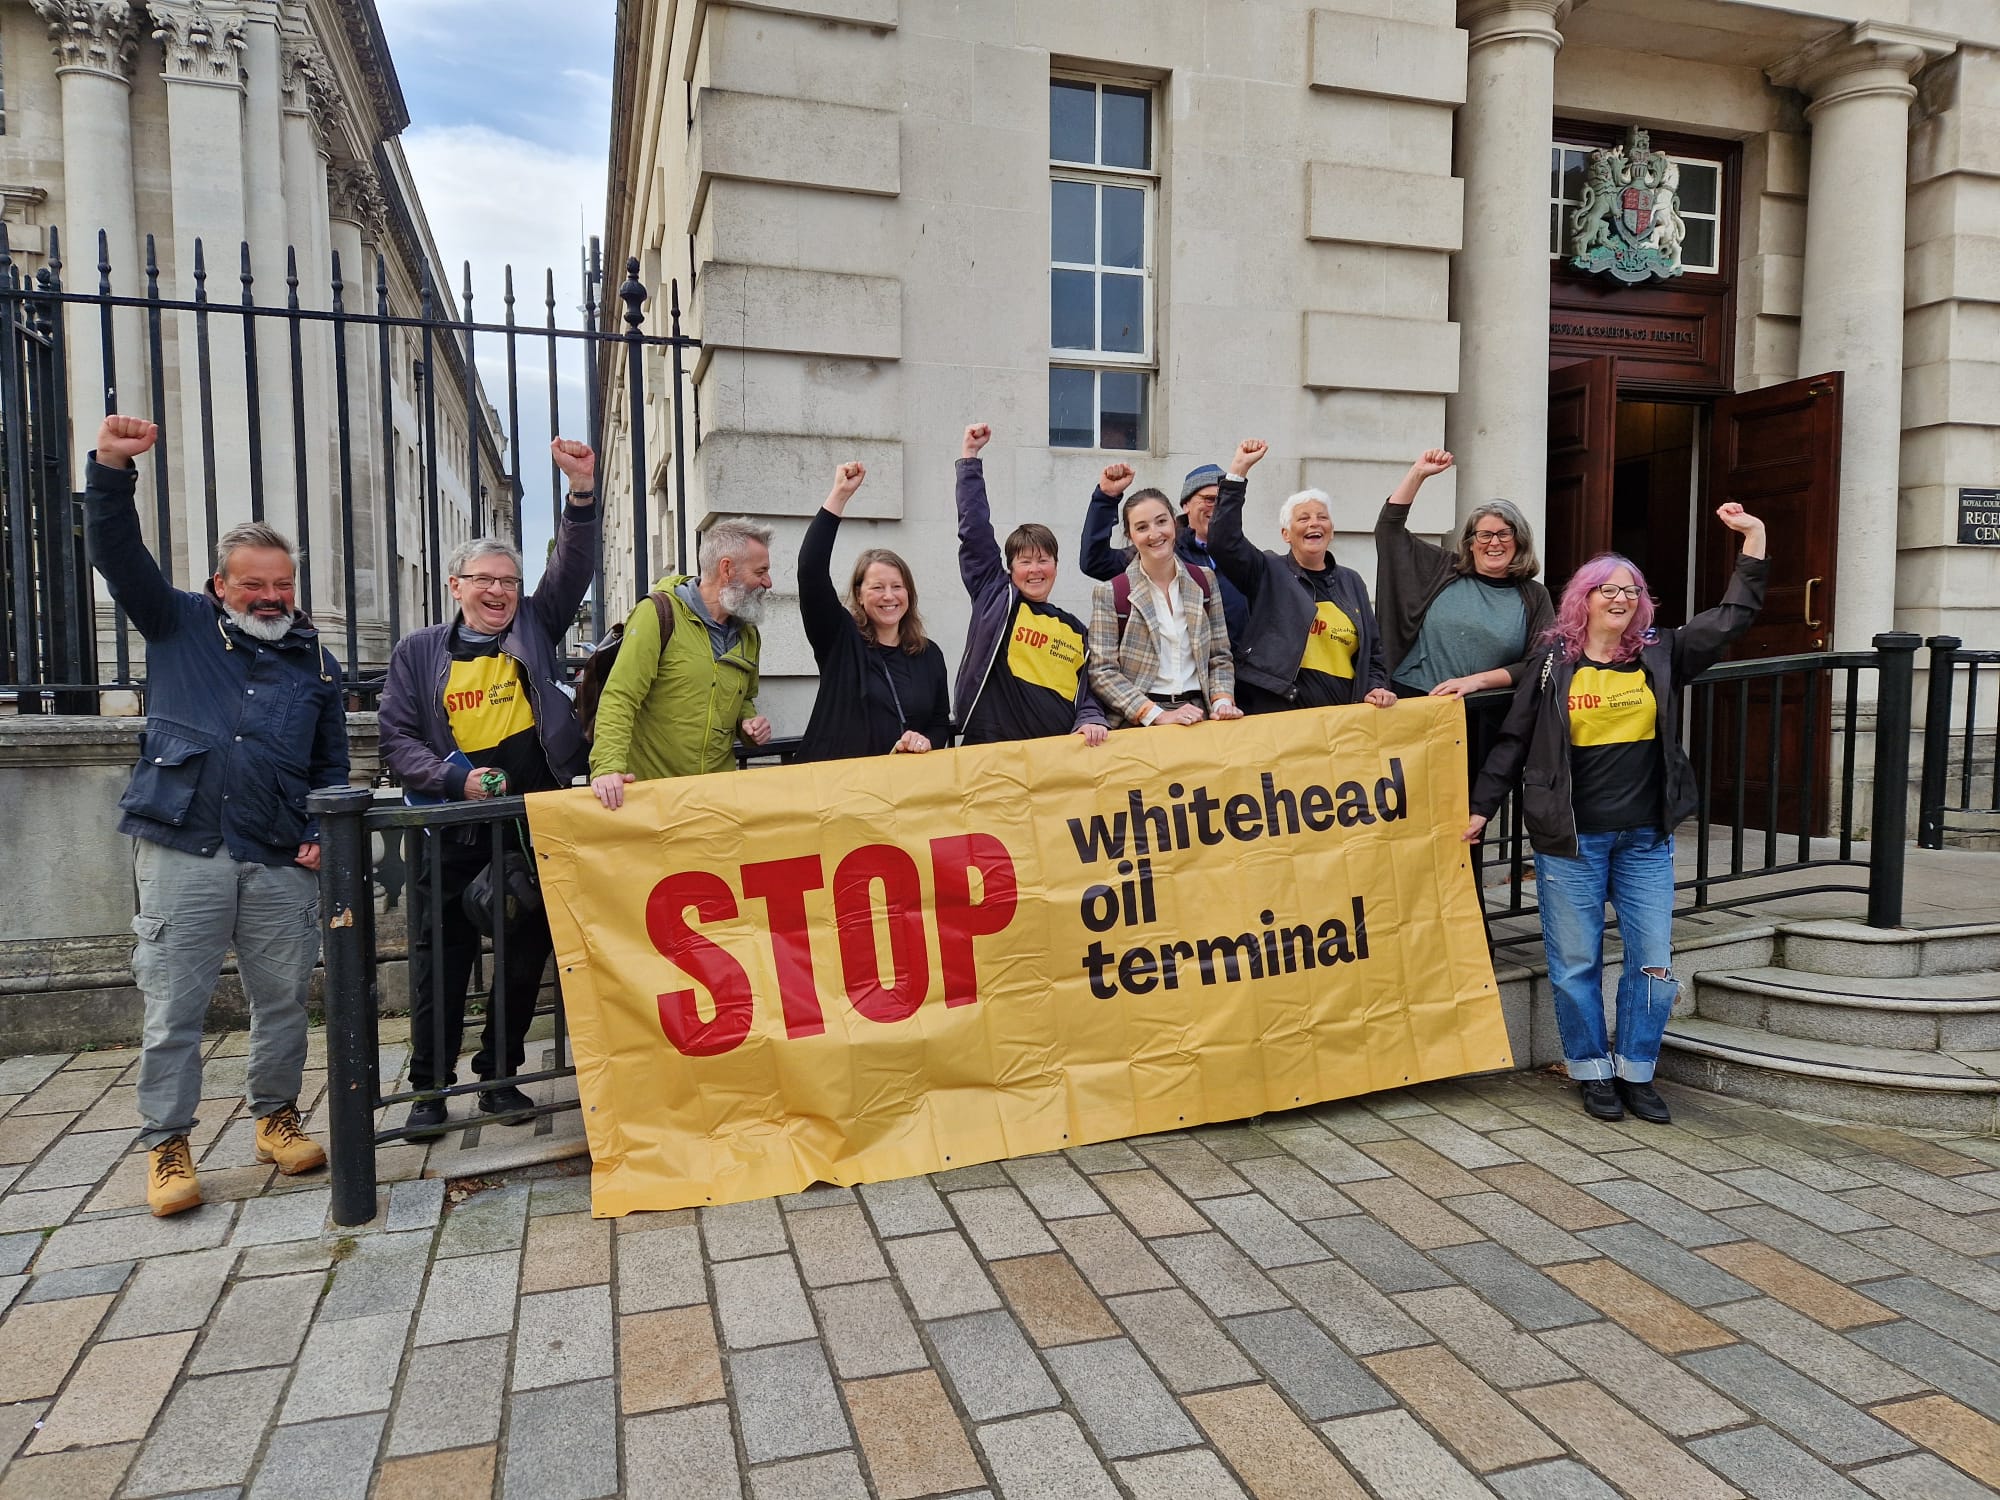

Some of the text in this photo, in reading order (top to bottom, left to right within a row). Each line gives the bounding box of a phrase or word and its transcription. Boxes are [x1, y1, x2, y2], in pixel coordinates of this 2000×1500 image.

[1652, 329, 1696, 343] JUSTICE
[1965, 511, 2000, 525] RECE
[1015, 626, 1048, 649] STOP
[446, 689, 484, 713] STOP
[1567, 693, 1602, 711] STOP
[1609, 698, 1643, 708] terminal
[1066, 757, 1407, 864] whitehead
[1080, 857, 1157, 933] oil
[645, 832, 1018, 1057] STOP
[1081, 895, 1370, 1000] terminal
